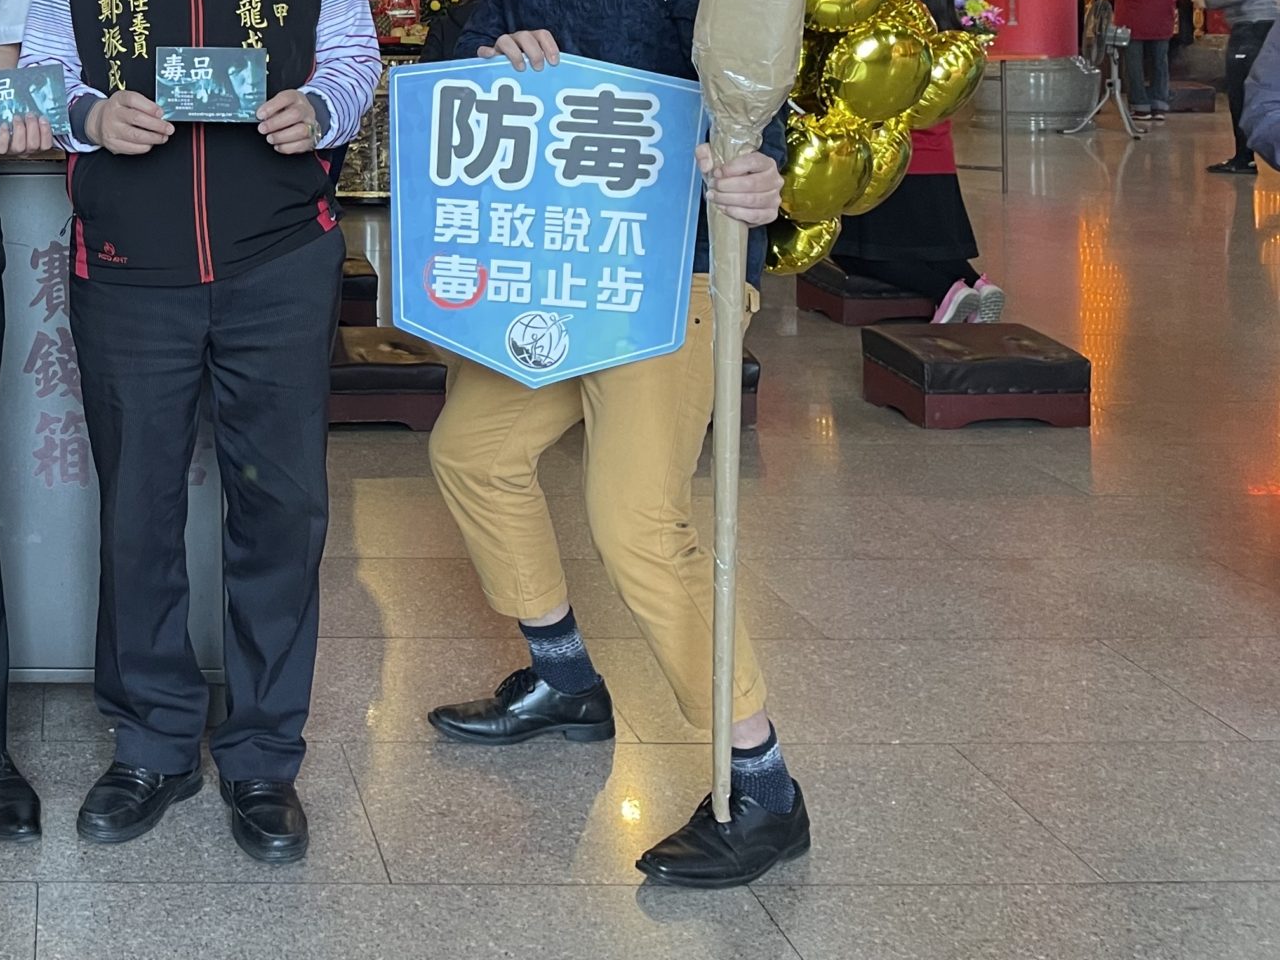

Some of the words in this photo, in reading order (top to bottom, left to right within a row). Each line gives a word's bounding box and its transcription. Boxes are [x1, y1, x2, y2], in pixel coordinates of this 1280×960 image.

[160, 54, 213, 81] 毒品
[432, 80, 661, 195] 防毒
[432, 196, 649, 257] 勇敢說不
[431, 253, 646, 314] 毒品止步
[23, 240, 91, 489] 賽錢箱
